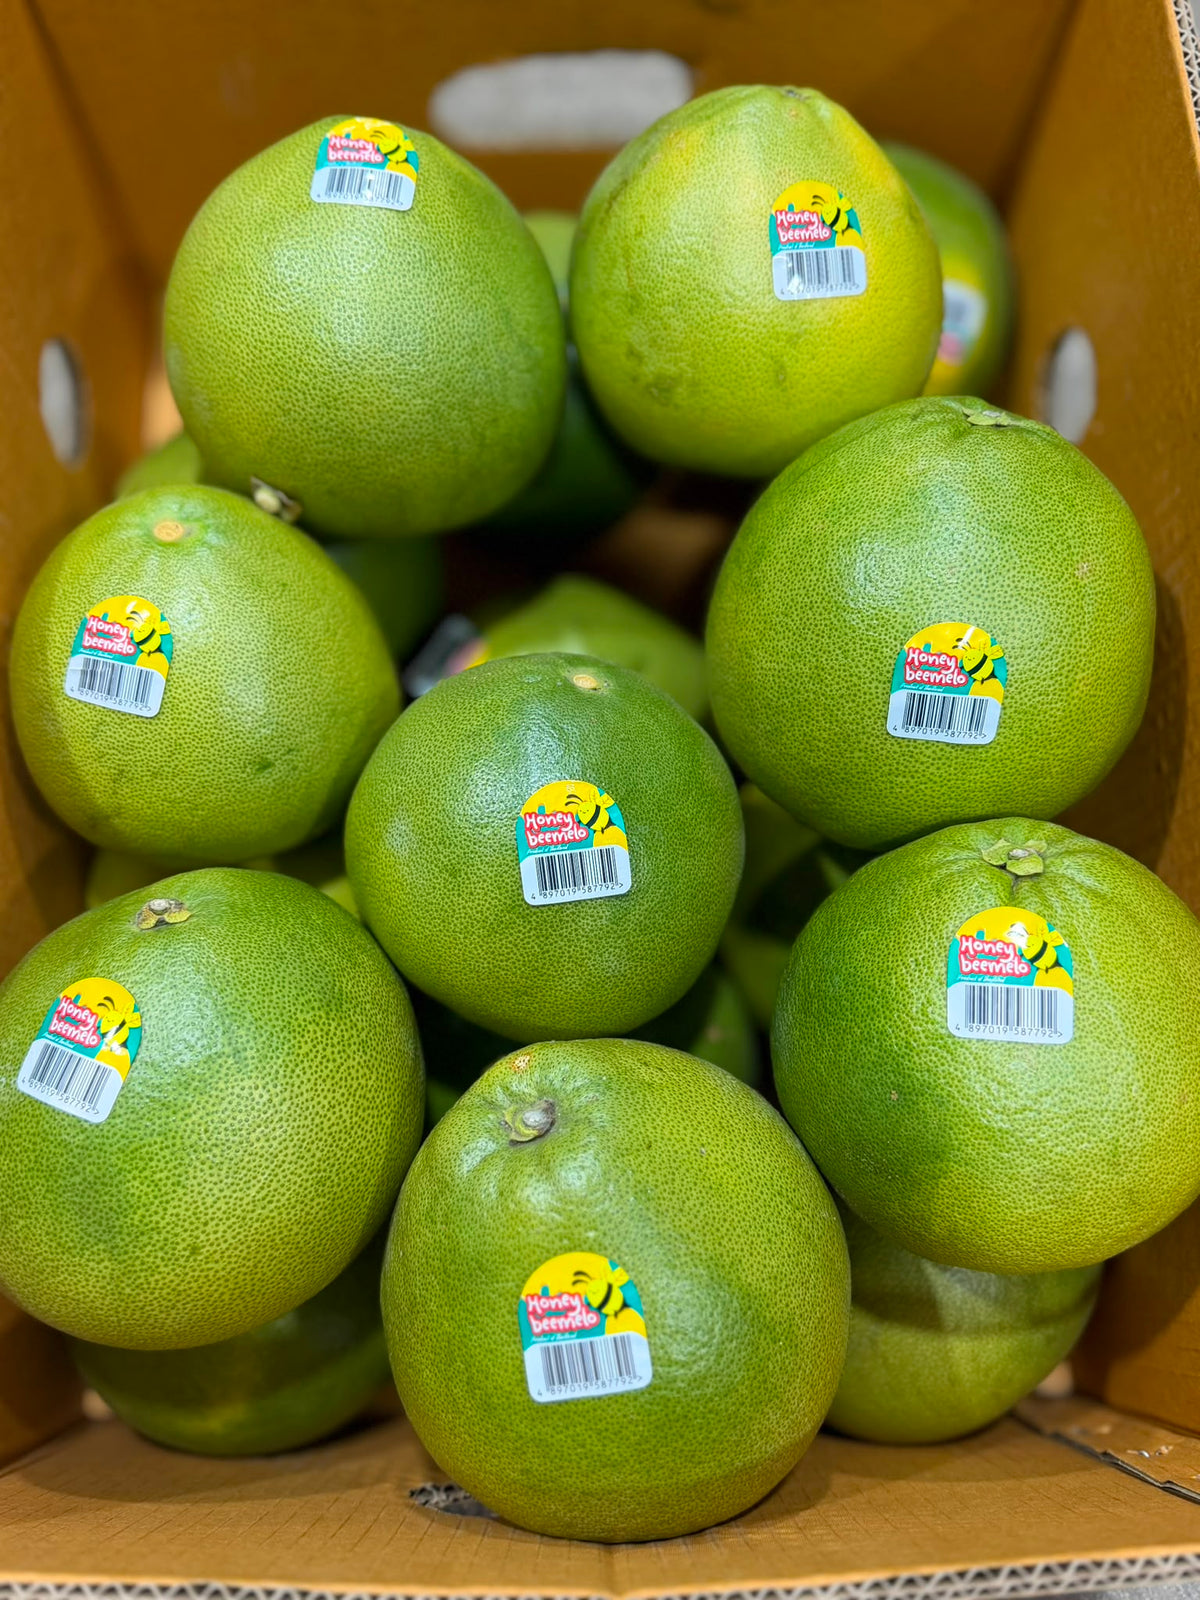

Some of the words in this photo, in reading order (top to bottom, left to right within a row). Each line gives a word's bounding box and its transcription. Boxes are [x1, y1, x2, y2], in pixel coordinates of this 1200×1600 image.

[328, 147, 383, 163] beemelo
[330, 136, 374, 153] Honey
[776, 210, 818, 230] Honey
[778, 223, 831, 242] beemelo
[87, 616, 128, 642] Honey
[83, 631, 134, 654] beemelo
[907, 648, 956, 674] Honey
[905, 665, 966, 685] beemelo
[904, 726, 940, 736] 897019
[944, 729, 978, 740] 587792
[525, 811, 573, 832] Honey
[527, 823, 587, 846] beemelo
[542, 888, 577, 899] 897019
[582, 882, 615, 894] 587792
[960, 936, 1014, 963] Honey
[960, 954, 1030, 975] beemelo
[58, 997, 97, 1030] Honey
[50, 1014, 99, 1046] beemelo
[968, 1024, 1008, 1035] 897019
[1014, 1027, 1054, 1038] 587792
[58, 1093, 92, 1113] 587792
[526, 1293, 581, 1317] Honey
[529, 1308, 598, 1333] beemelo
[550, 1382, 588, 1396] 897019
[594, 1376, 633, 1389] 587792
